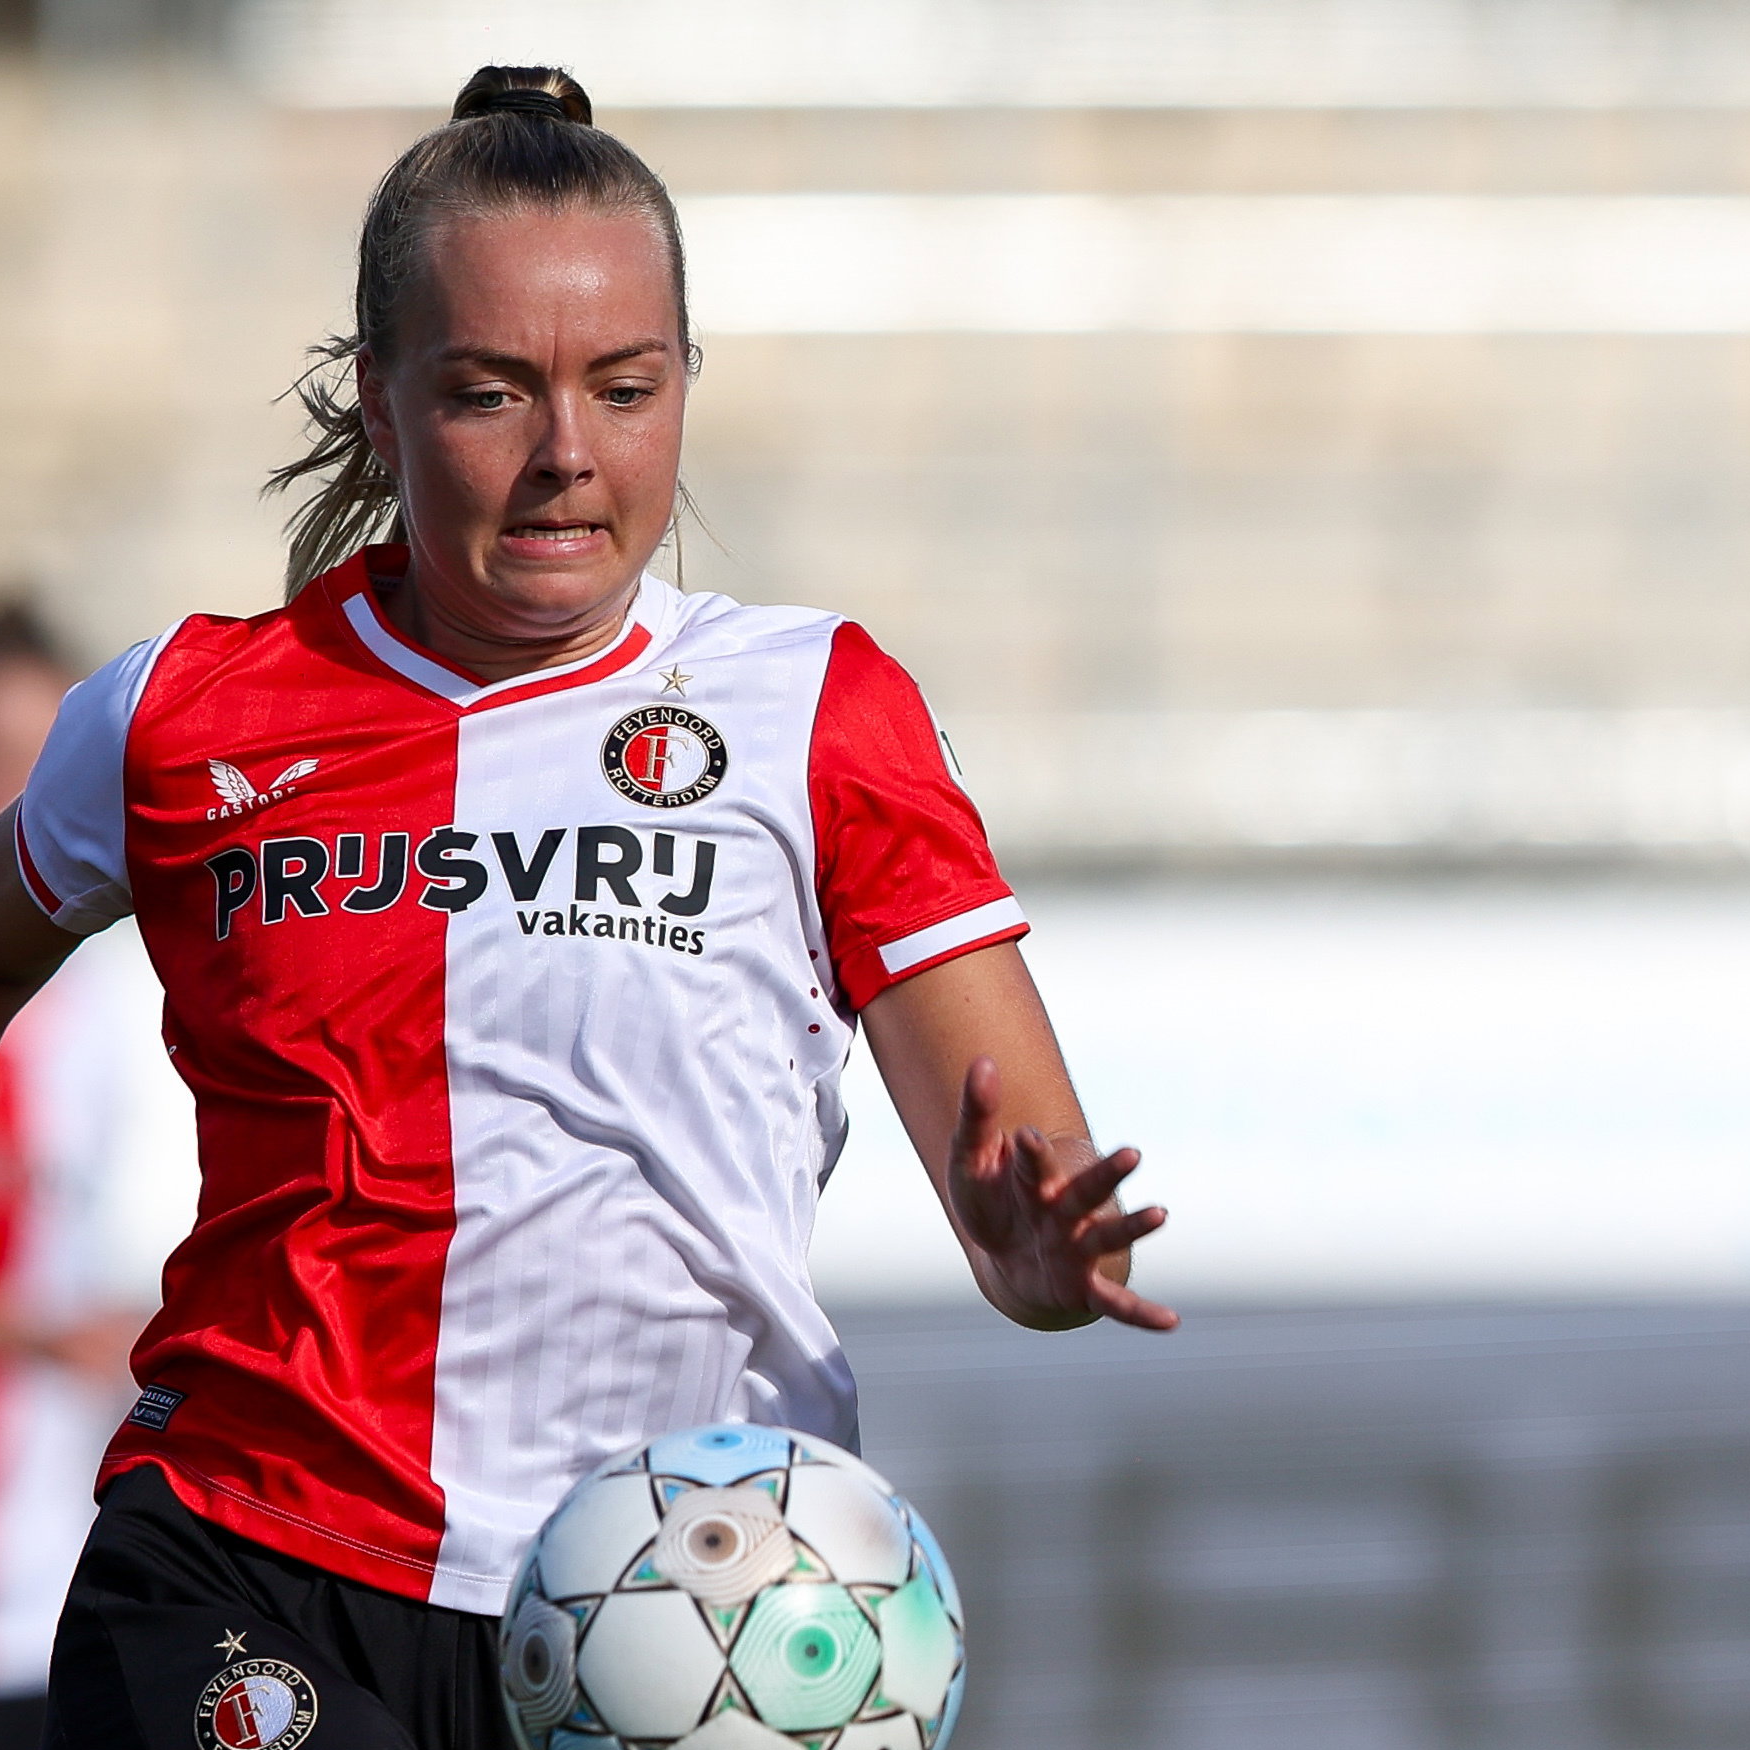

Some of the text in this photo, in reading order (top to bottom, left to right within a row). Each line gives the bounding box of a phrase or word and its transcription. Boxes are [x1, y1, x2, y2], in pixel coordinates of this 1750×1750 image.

[613, 708, 722, 750] FEYENOORD
[637, 734, 689, 783] F
[608, 766, 720, 806] ROTTERDAM
[203, 823, 718, 942] PRIJSVRIJ
[517, 903, 707, 957] vakanties
[198, 1662, 301, 1718] FEYENOORD
[222, 1685, 271, 1746] F
